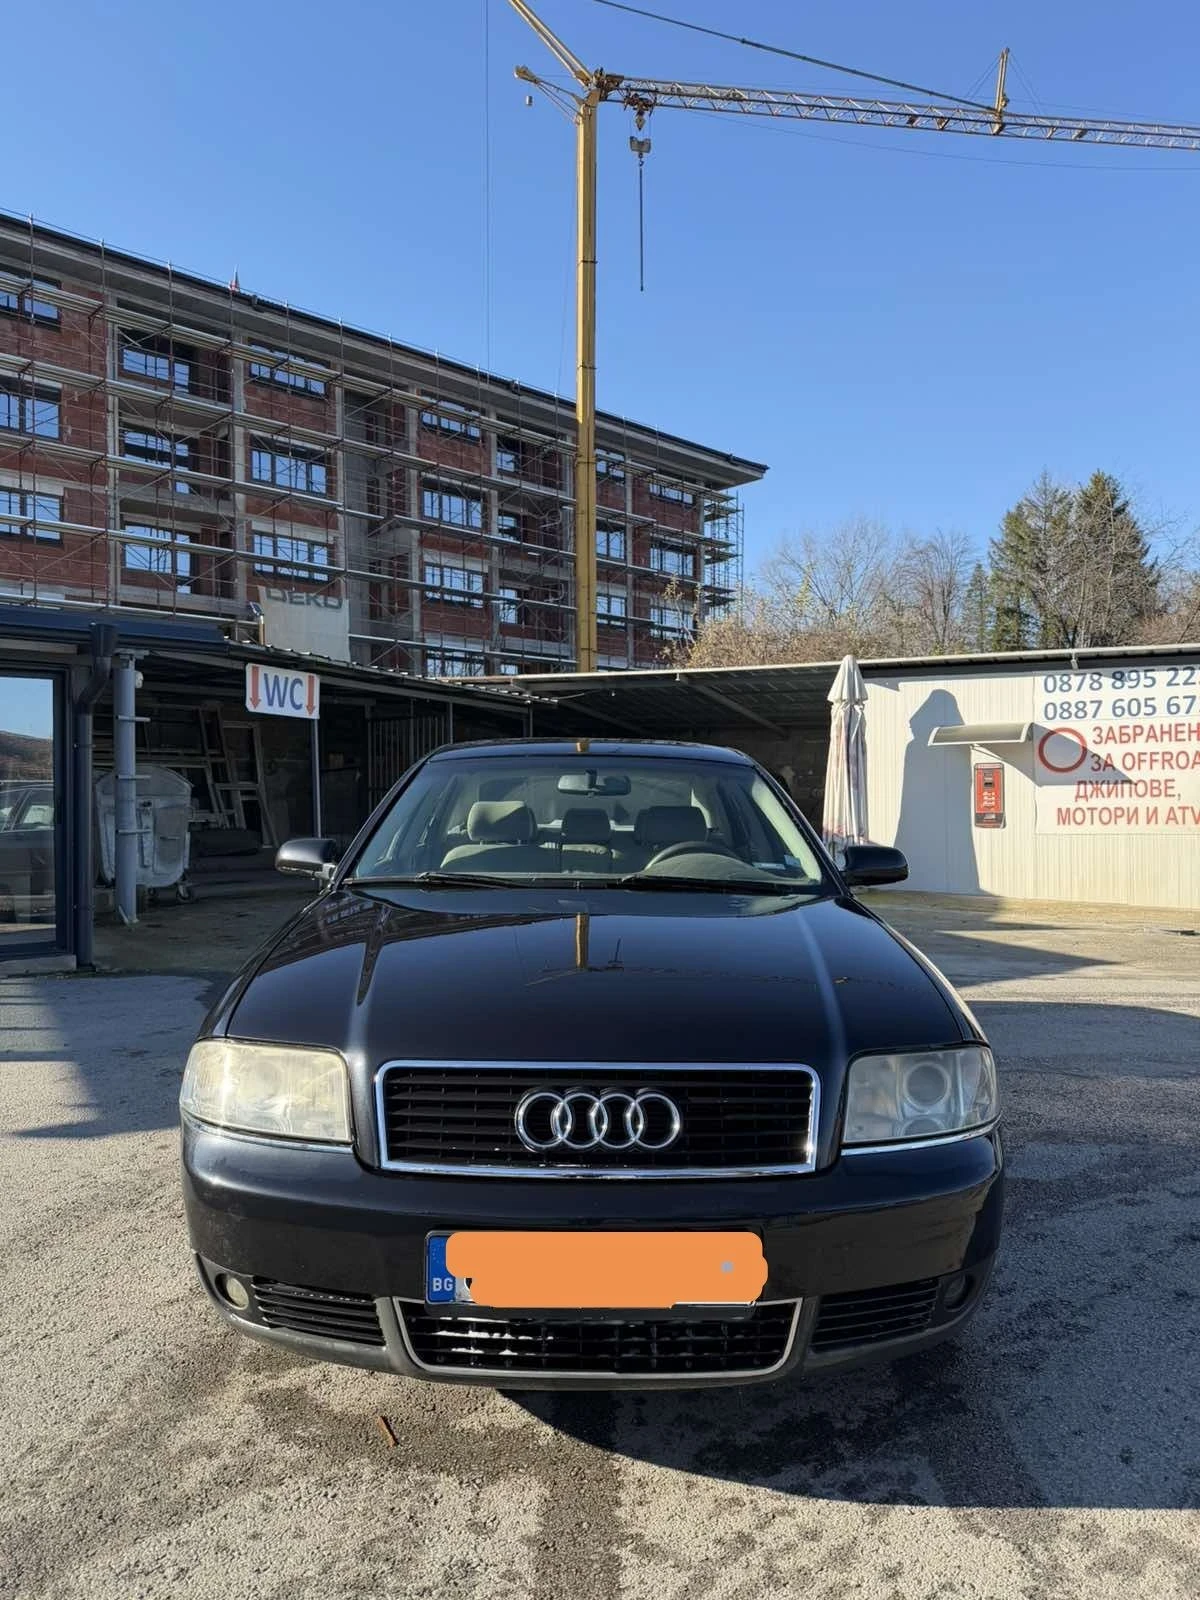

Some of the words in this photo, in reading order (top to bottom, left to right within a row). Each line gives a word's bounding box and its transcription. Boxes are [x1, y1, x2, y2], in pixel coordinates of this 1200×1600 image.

[263, 672, 303, 710] WC
[1043, 672, 1103, 693] 0878
[1111, 669, 1157, 689] 895
[1166, 665, 1200, 687] 22
[1043, 700, 1103, 721] 0887
[1111, 697, 1157, 718] 605
[1166, 694, 1200, 715] 67
[1090, 752, 1116, 772] ЗА
[1074, 778, 1181, 803] ДЖИПОВЕ,
[1056, 806, 1139, 826] МОТОРИ
[1146, 806, 1159, 825] И
[1165, 805, 1200, 825] ATV
[432, 1277, 454, 1292] BG
